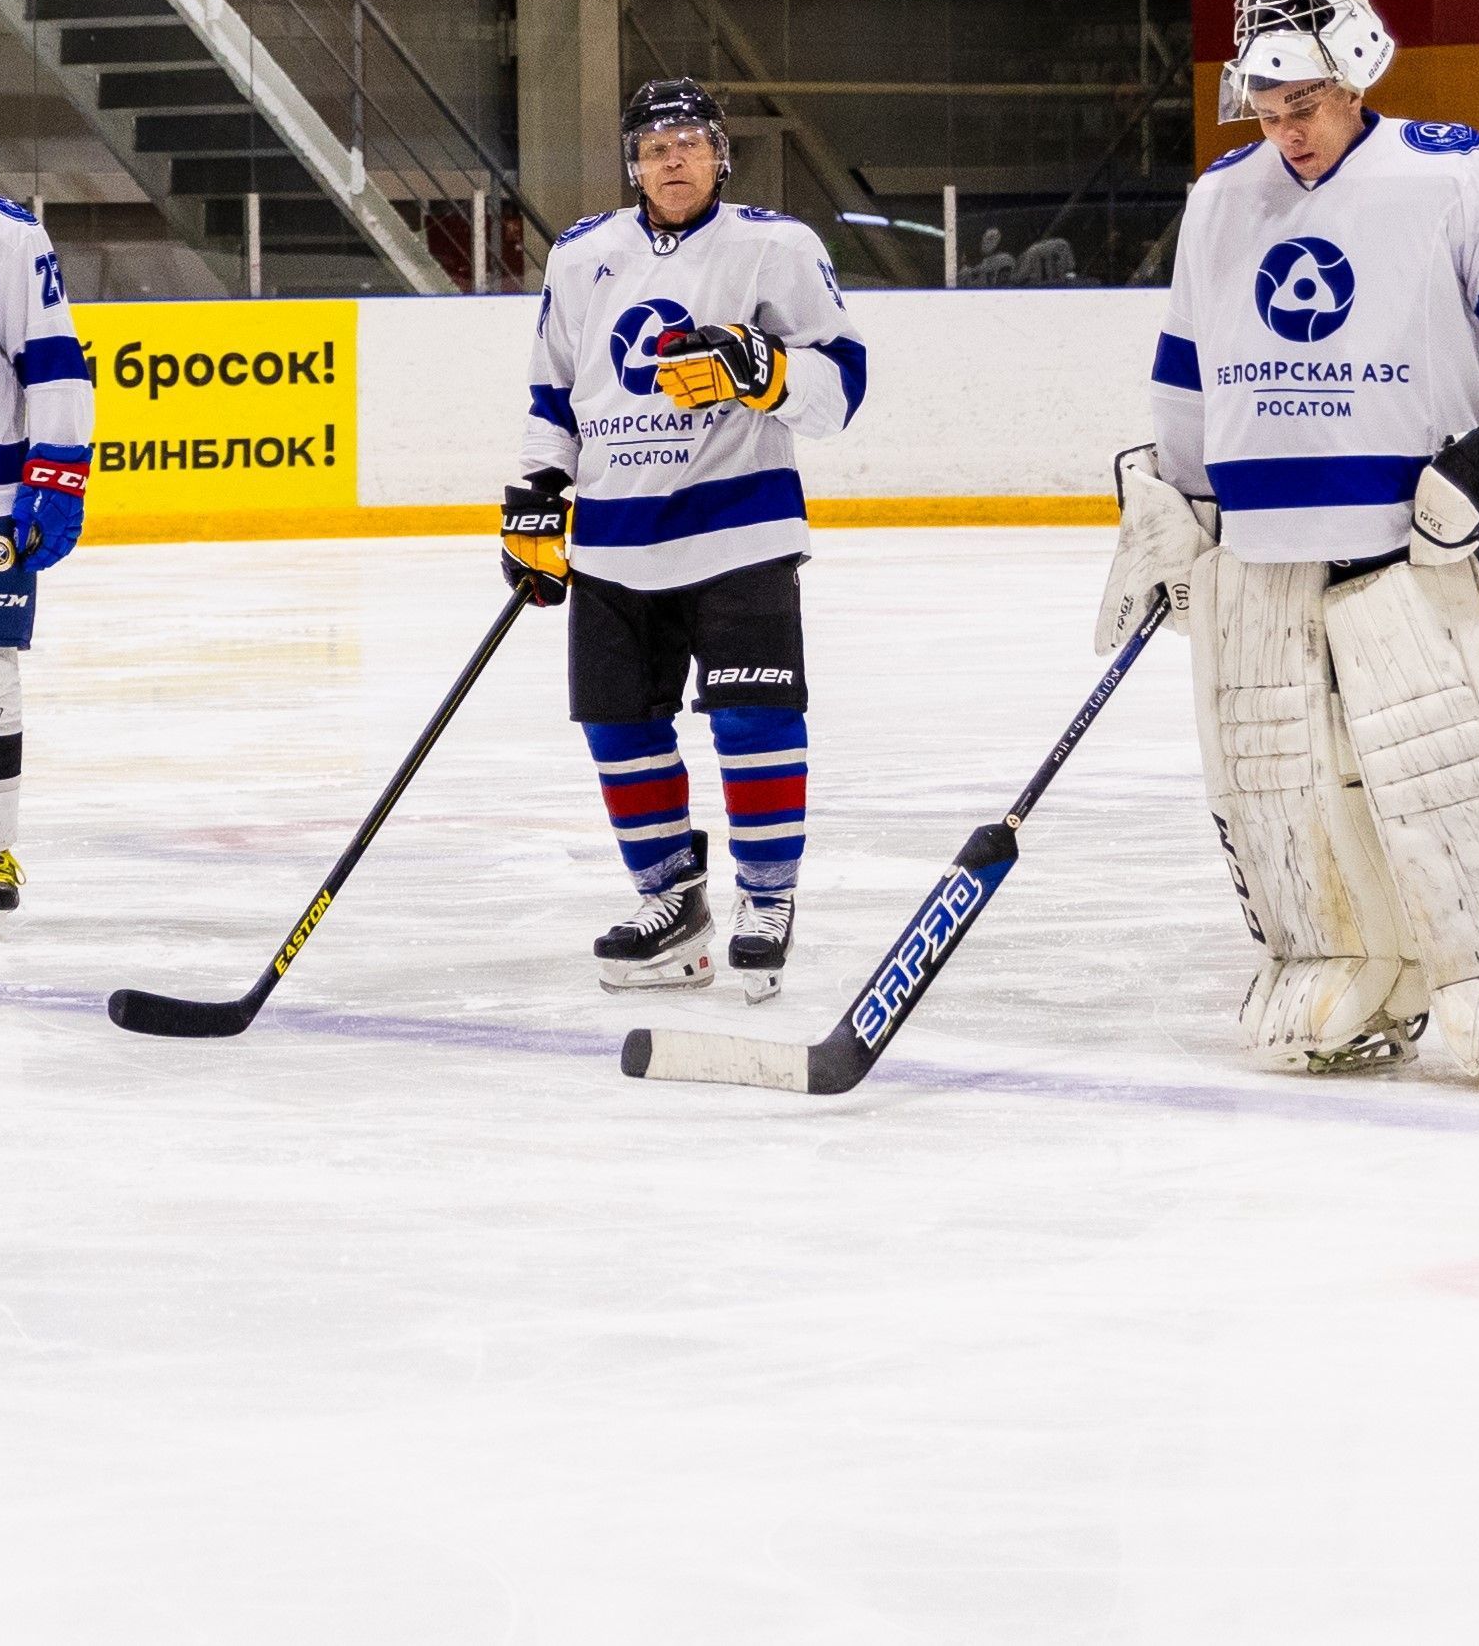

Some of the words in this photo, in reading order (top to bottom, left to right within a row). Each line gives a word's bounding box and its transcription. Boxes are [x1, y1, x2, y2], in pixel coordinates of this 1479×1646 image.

[113, 340, 336, 400] бросок!
[1216, 361, 1353, 385] БЕЛОЯРСКАЯ
[1361, 363, 1410, 384] АЭС
[1256, 399, 1352, 418] РОСАТОМ
[609, 448, 690, 469] РОСАТОМ
[28, 466, 88, 491] CC
[273, 888, 333, 977] EASTON
[851, 865, 983, 1050] ЗАРЯД
